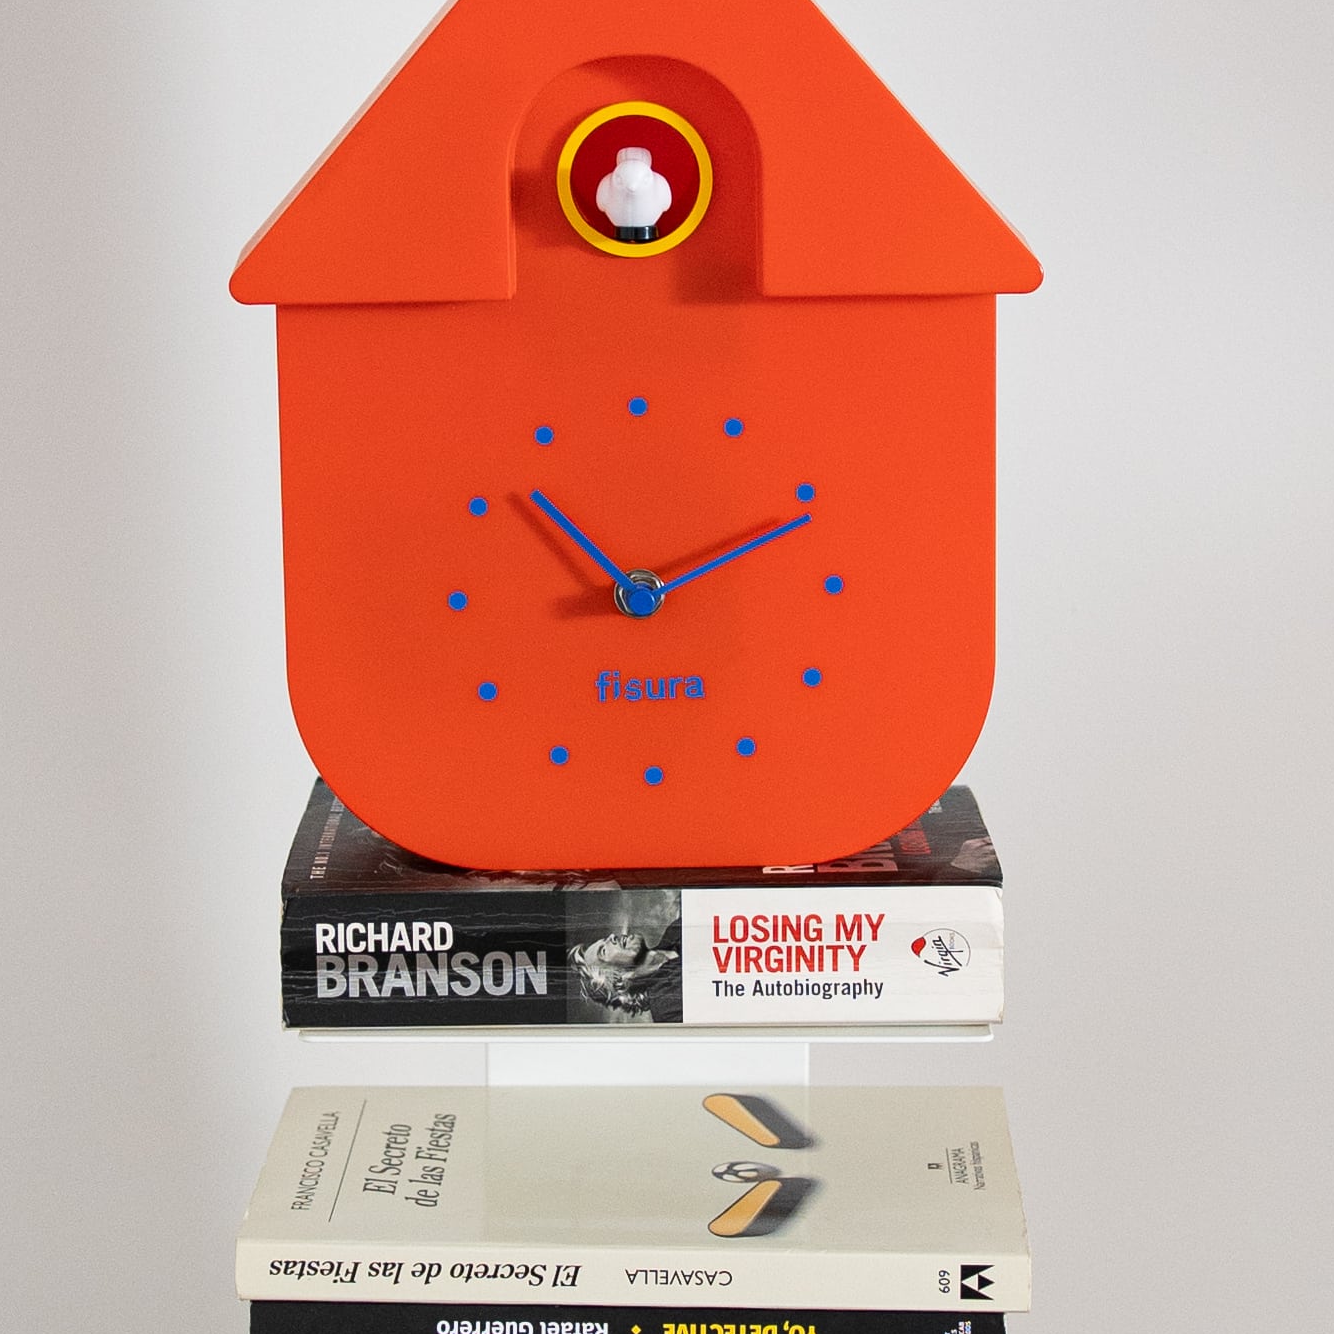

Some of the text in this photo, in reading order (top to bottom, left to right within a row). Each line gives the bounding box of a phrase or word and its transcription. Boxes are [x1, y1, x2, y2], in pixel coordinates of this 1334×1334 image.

[596, 671, 704, 702] fisura
[315, 921, 453, 954] RICHARD
[713, 913, 885, 944] LOSING MY
[712, 944, 867, 974] VIRGINITY
[923, 936, 964, 977] Virgin
[316, 951, 547, 998] BRANSON
[712, 979, 883, 999] The Autobiography
[363, 1123, 413, 1196] El Secreto
[405, 1113, 457, 1208] de las Fiestas
[950, 1147, 965, 1184] ANAGRAMA
[291, 1156, 317, 1211] FRANCISCO
[269, 1260, 733, 1287] CASAVELLA El Secreto de las Fiestas
[938, 1269, 950, 1294] 609
